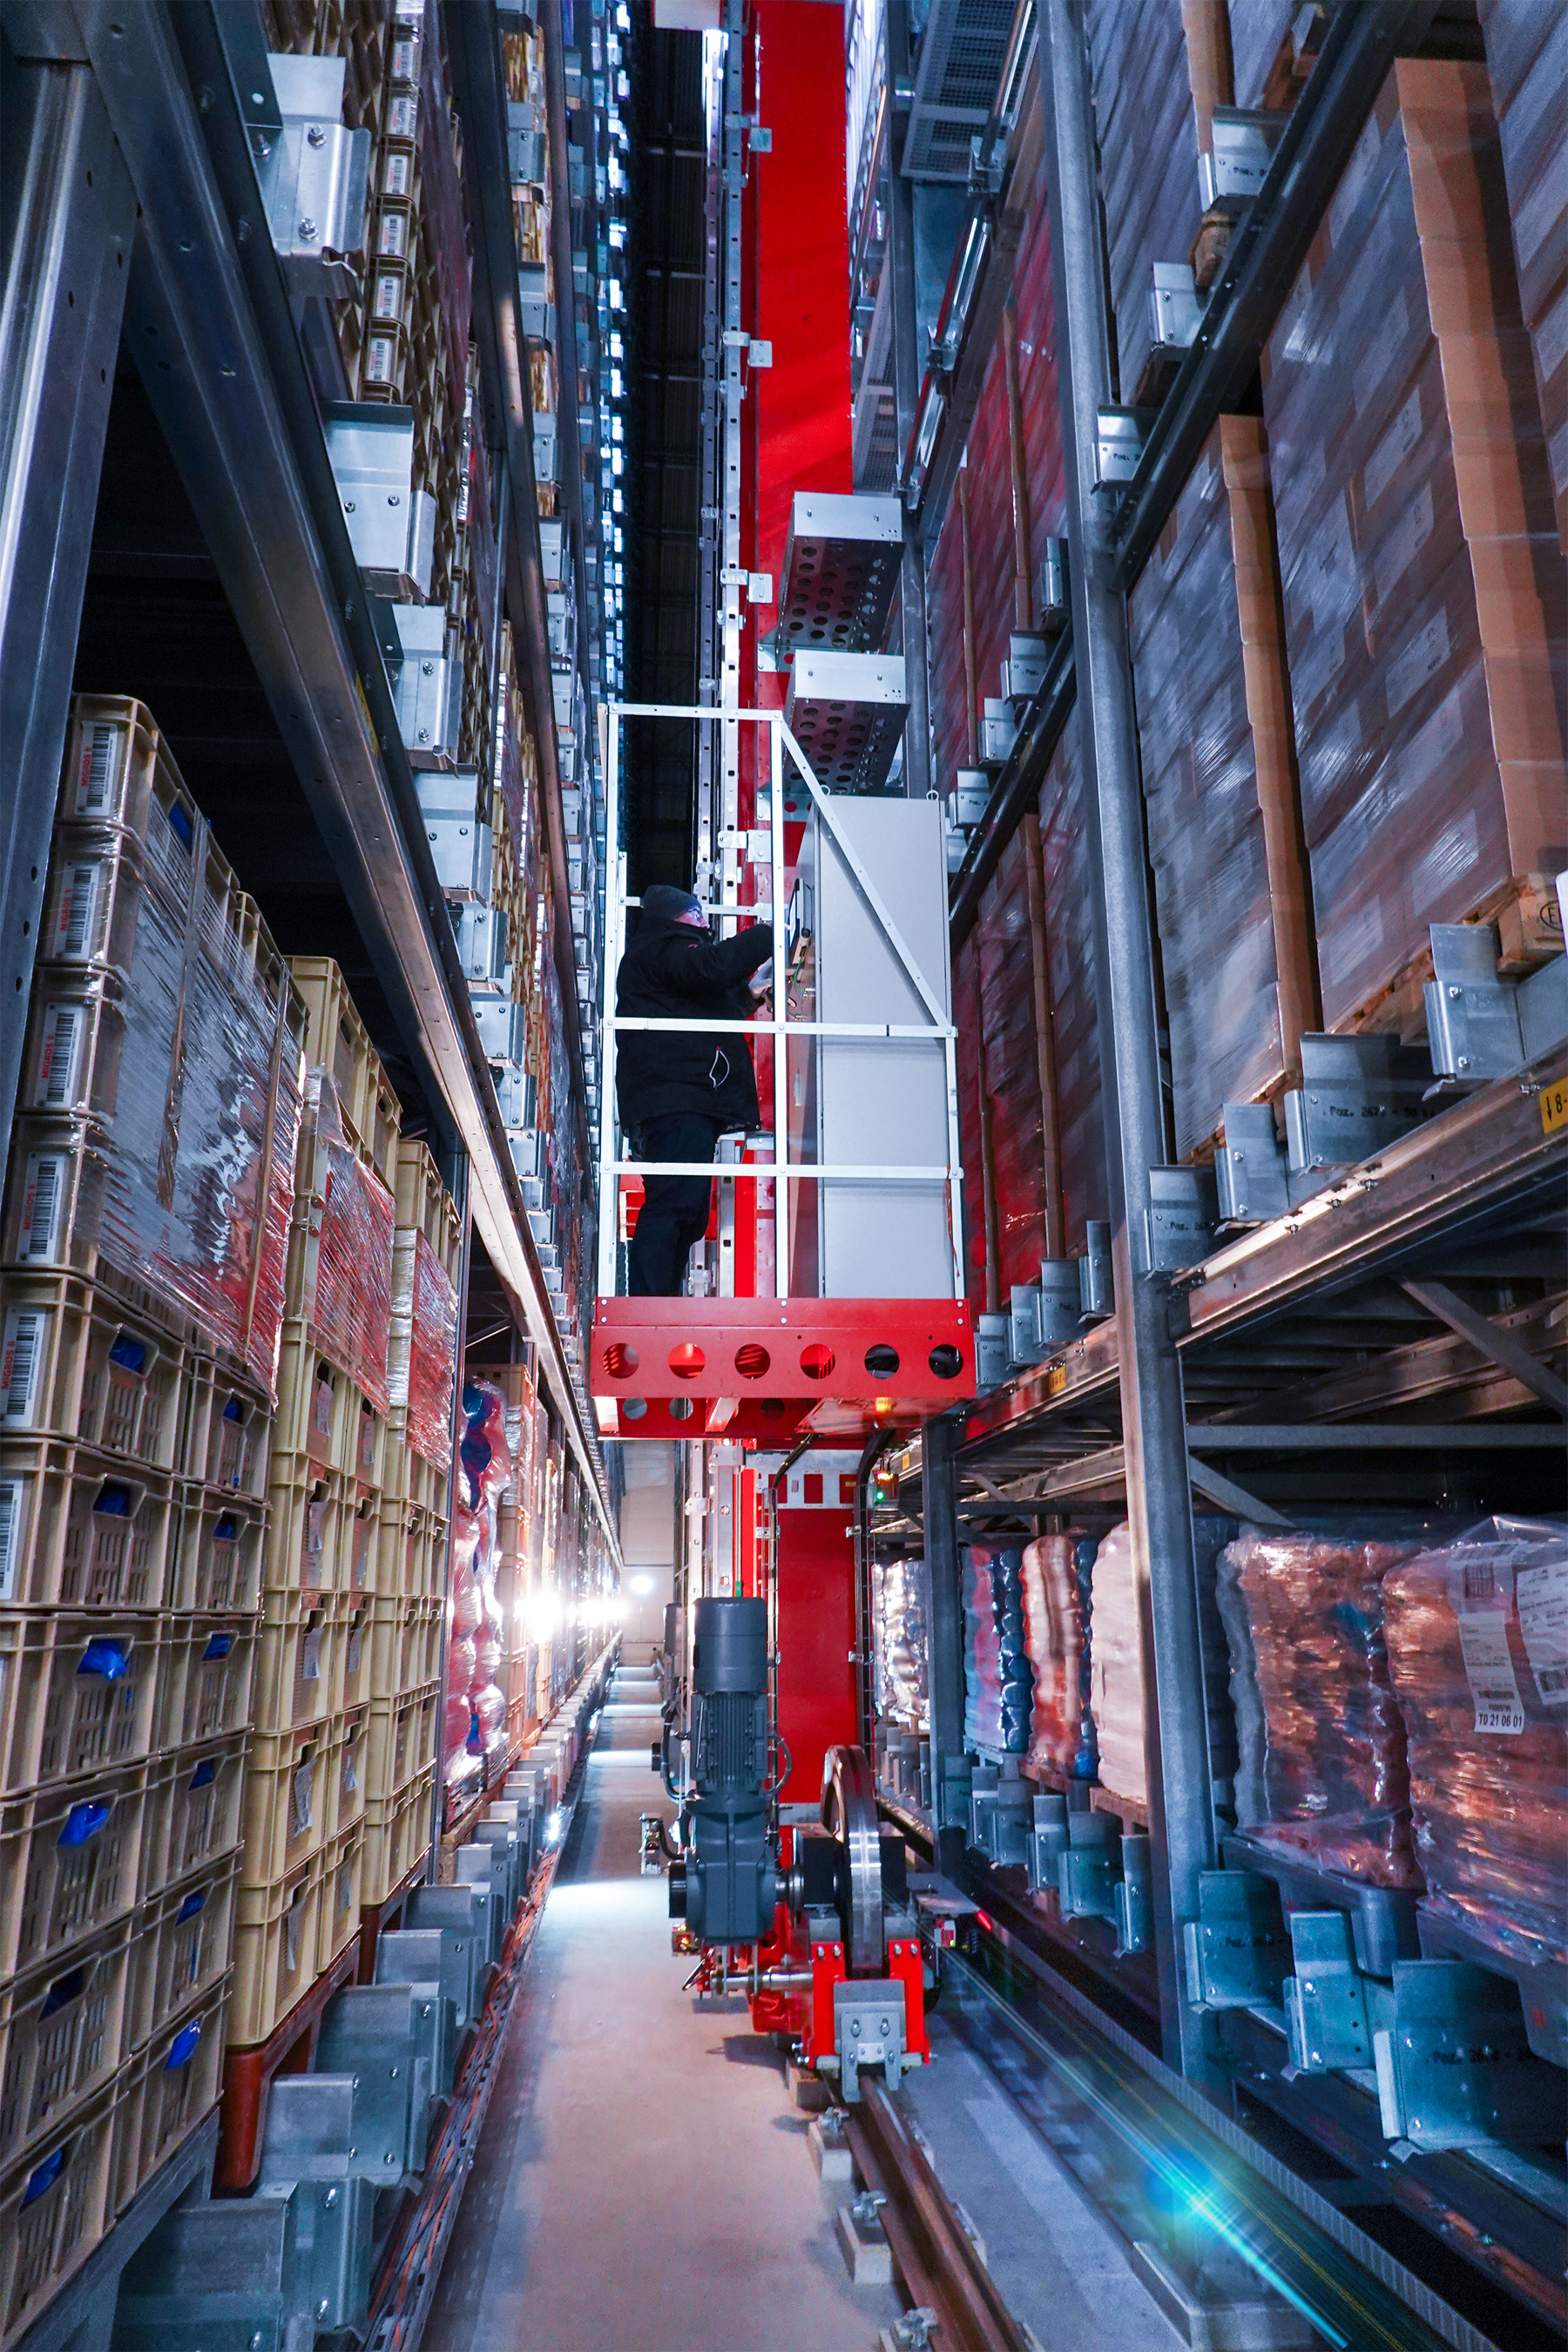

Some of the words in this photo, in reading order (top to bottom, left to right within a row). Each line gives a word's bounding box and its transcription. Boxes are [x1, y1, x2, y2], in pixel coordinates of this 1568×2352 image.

[81, 754, 91, 787] MIGROS
[60, 897, 71, 931] MIGROS
[42, 1043, 53, 1078] MIGROS
[24, 1193, 36, 1231] MIGROS
[2, 1349, 14, 1389] MIGROS
[1490, 1713, 1499, 1727] 21
[1502, 1714, 1511, 1727] 06
[1513, 1715, 1523, 1728] 01
